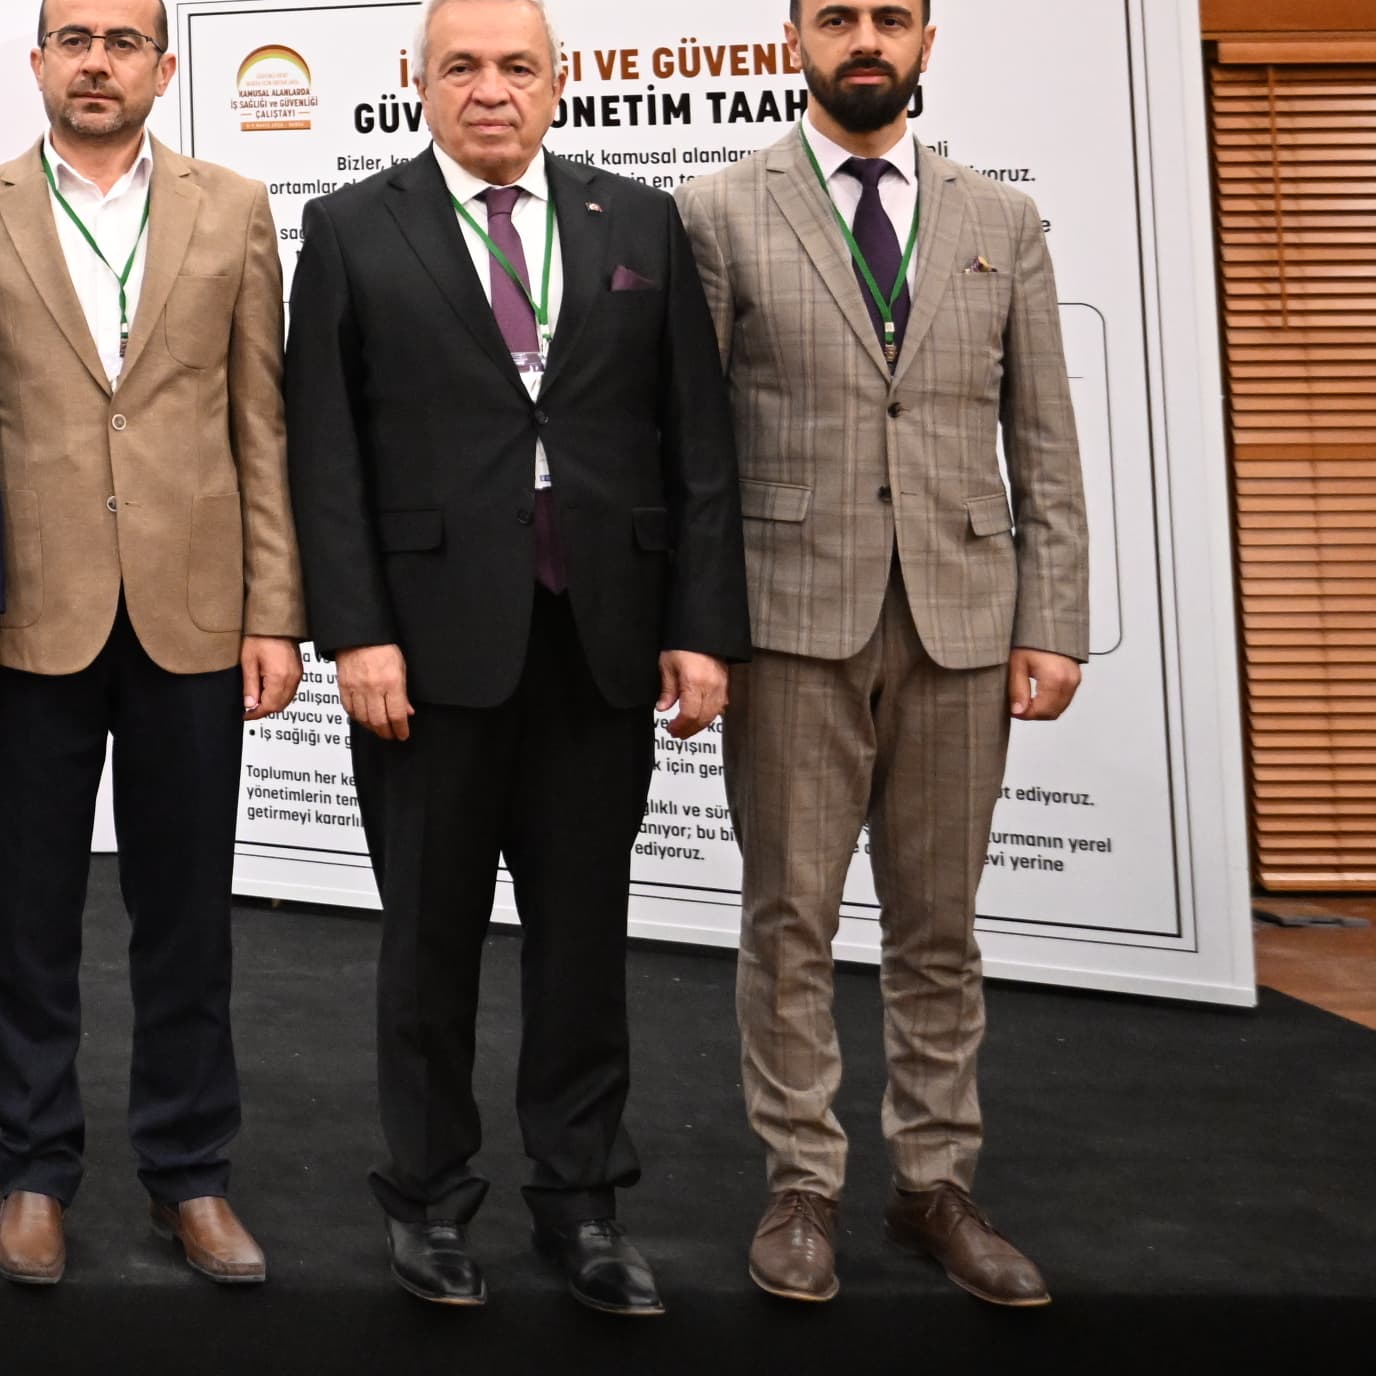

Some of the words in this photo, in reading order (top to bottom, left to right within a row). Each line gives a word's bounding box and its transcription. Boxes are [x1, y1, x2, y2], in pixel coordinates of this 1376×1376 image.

[593, 48, 640, 81] VE
[652, 37, 801, 79] GÜVENL
[601, 147, 677, 165] kamusal
[265, 709, 322, 723] oruyucu
[326, 714, 342, 725] ve
[654, 736, 717, 756] nlayışını
[260, 724, 272, 741] İş
[275, 727, 321, 746] sağlığı
[325, 734, 340, 745] ve
[666, 758, 695, 775] için
[1015, 786, 1095, 807] ediyoruz.
[246, 765, 311, 782] Toplumun
[315, 769, 336, 784] her
[683, 805, 701, 817] ve
[989, 831, 1064, 848] urmanın
[1068, 837, 1112, 854] yerel
[246, 784, 332, 805] yönetimlerin
[639, 823, 692, 840] anıyor;
[697, 825, 715, 840] bu
[1010, 854, 1064, 872] yerine
[247, 805, 311, 825] getirmeyi
[315, 809, 364, 828] kararlı
[634, 843, 705, 861] ediyoruz.
